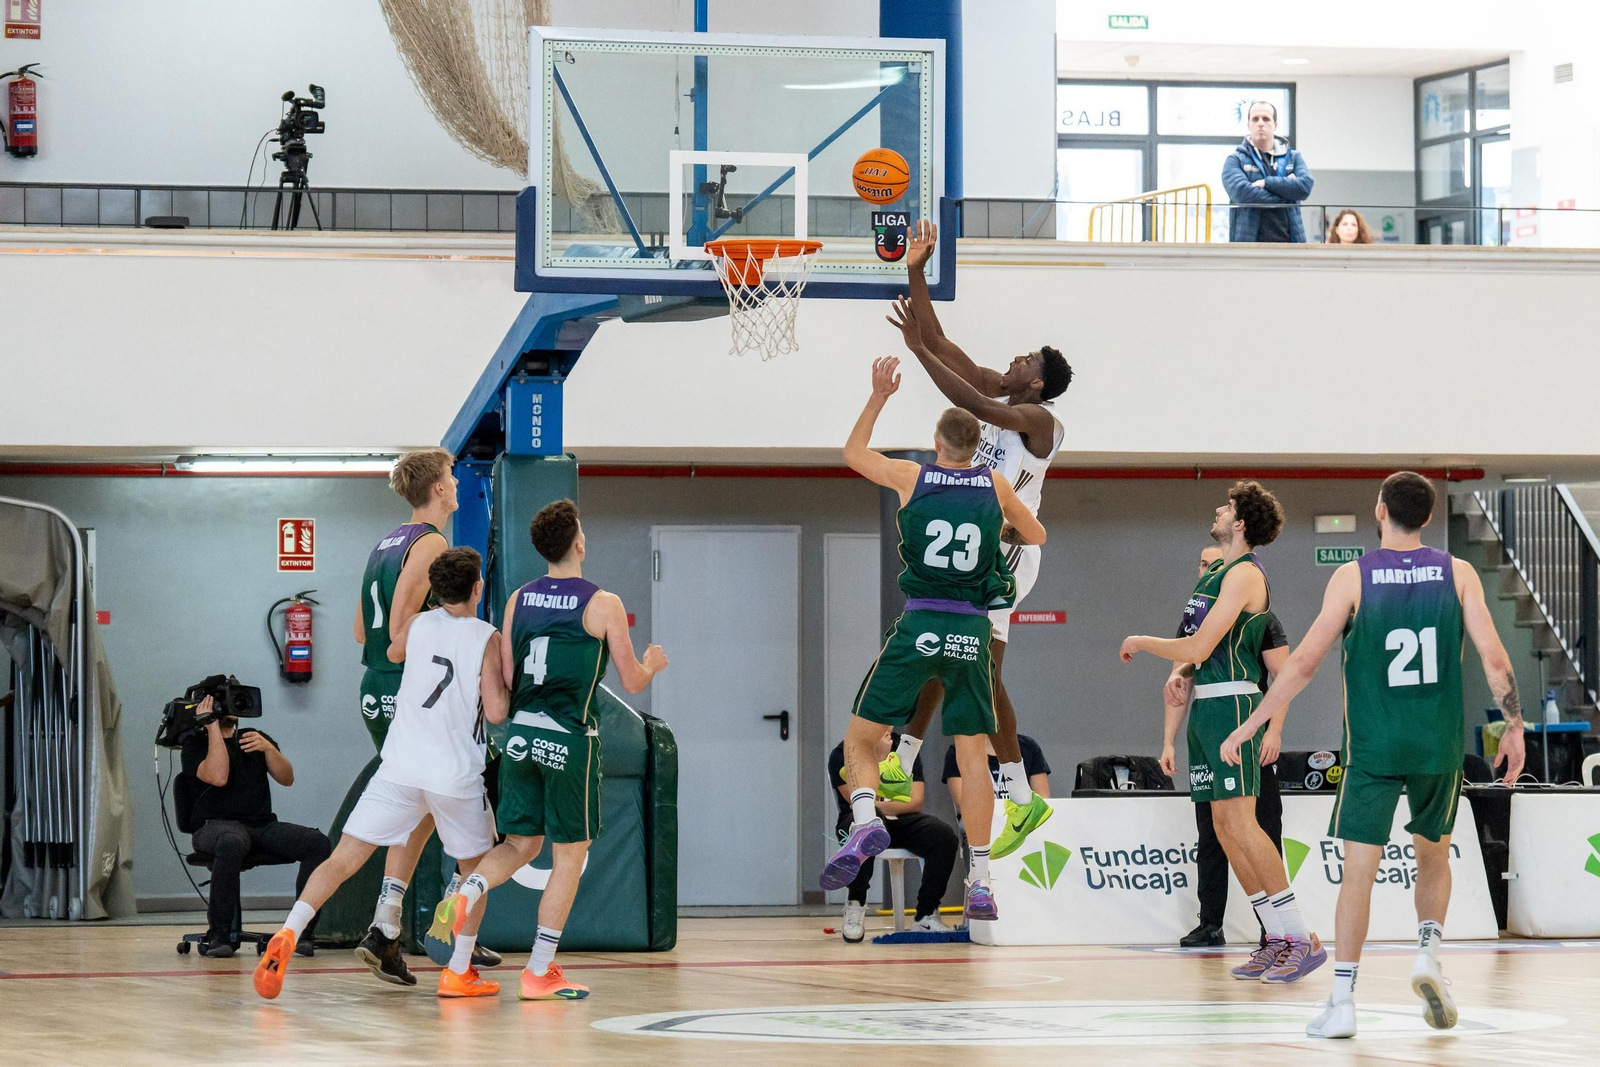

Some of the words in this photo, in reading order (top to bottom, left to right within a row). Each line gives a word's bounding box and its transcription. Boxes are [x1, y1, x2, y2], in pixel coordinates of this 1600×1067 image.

[1111, 16, 1146, 28] SALIDA
[7, 27, 39, 35] EXTINTOR
[856, 182, 893, 198] Wilson
[874, 214, 907, 226] LIGA
[531, 393, 543, 448] MONDO
[923, 519, 982, 572] 23
[1320, 549, 1359, 561] SALIDA
[1371, 565, 1444, 585] MARTÍNEZ
[370, 580, 384, 629] 1
[522, 591, 579, 610] TRUJILLO
[1018, 611, 1057, 622] ENFERMERÍA
[945, 633, 980, 646] COSTA
[943, 649, 977, 661] MÁLAGA
[944, 643, 962, 652] DEL
[963, 645, 979, 654] SOL
[1385, 626, 1438, 687] 21
[523, 636, 550, 685] 4
[421, 654, 454, 709] 7
[531, 747, 547, 759] DEL
[548, 752, 567, 763] SOL
[532, 738, 569, 755] COSTA
[1079, 842, 1199, 867] Fundació
[1085, 867, 1188, 895] Unicaja
